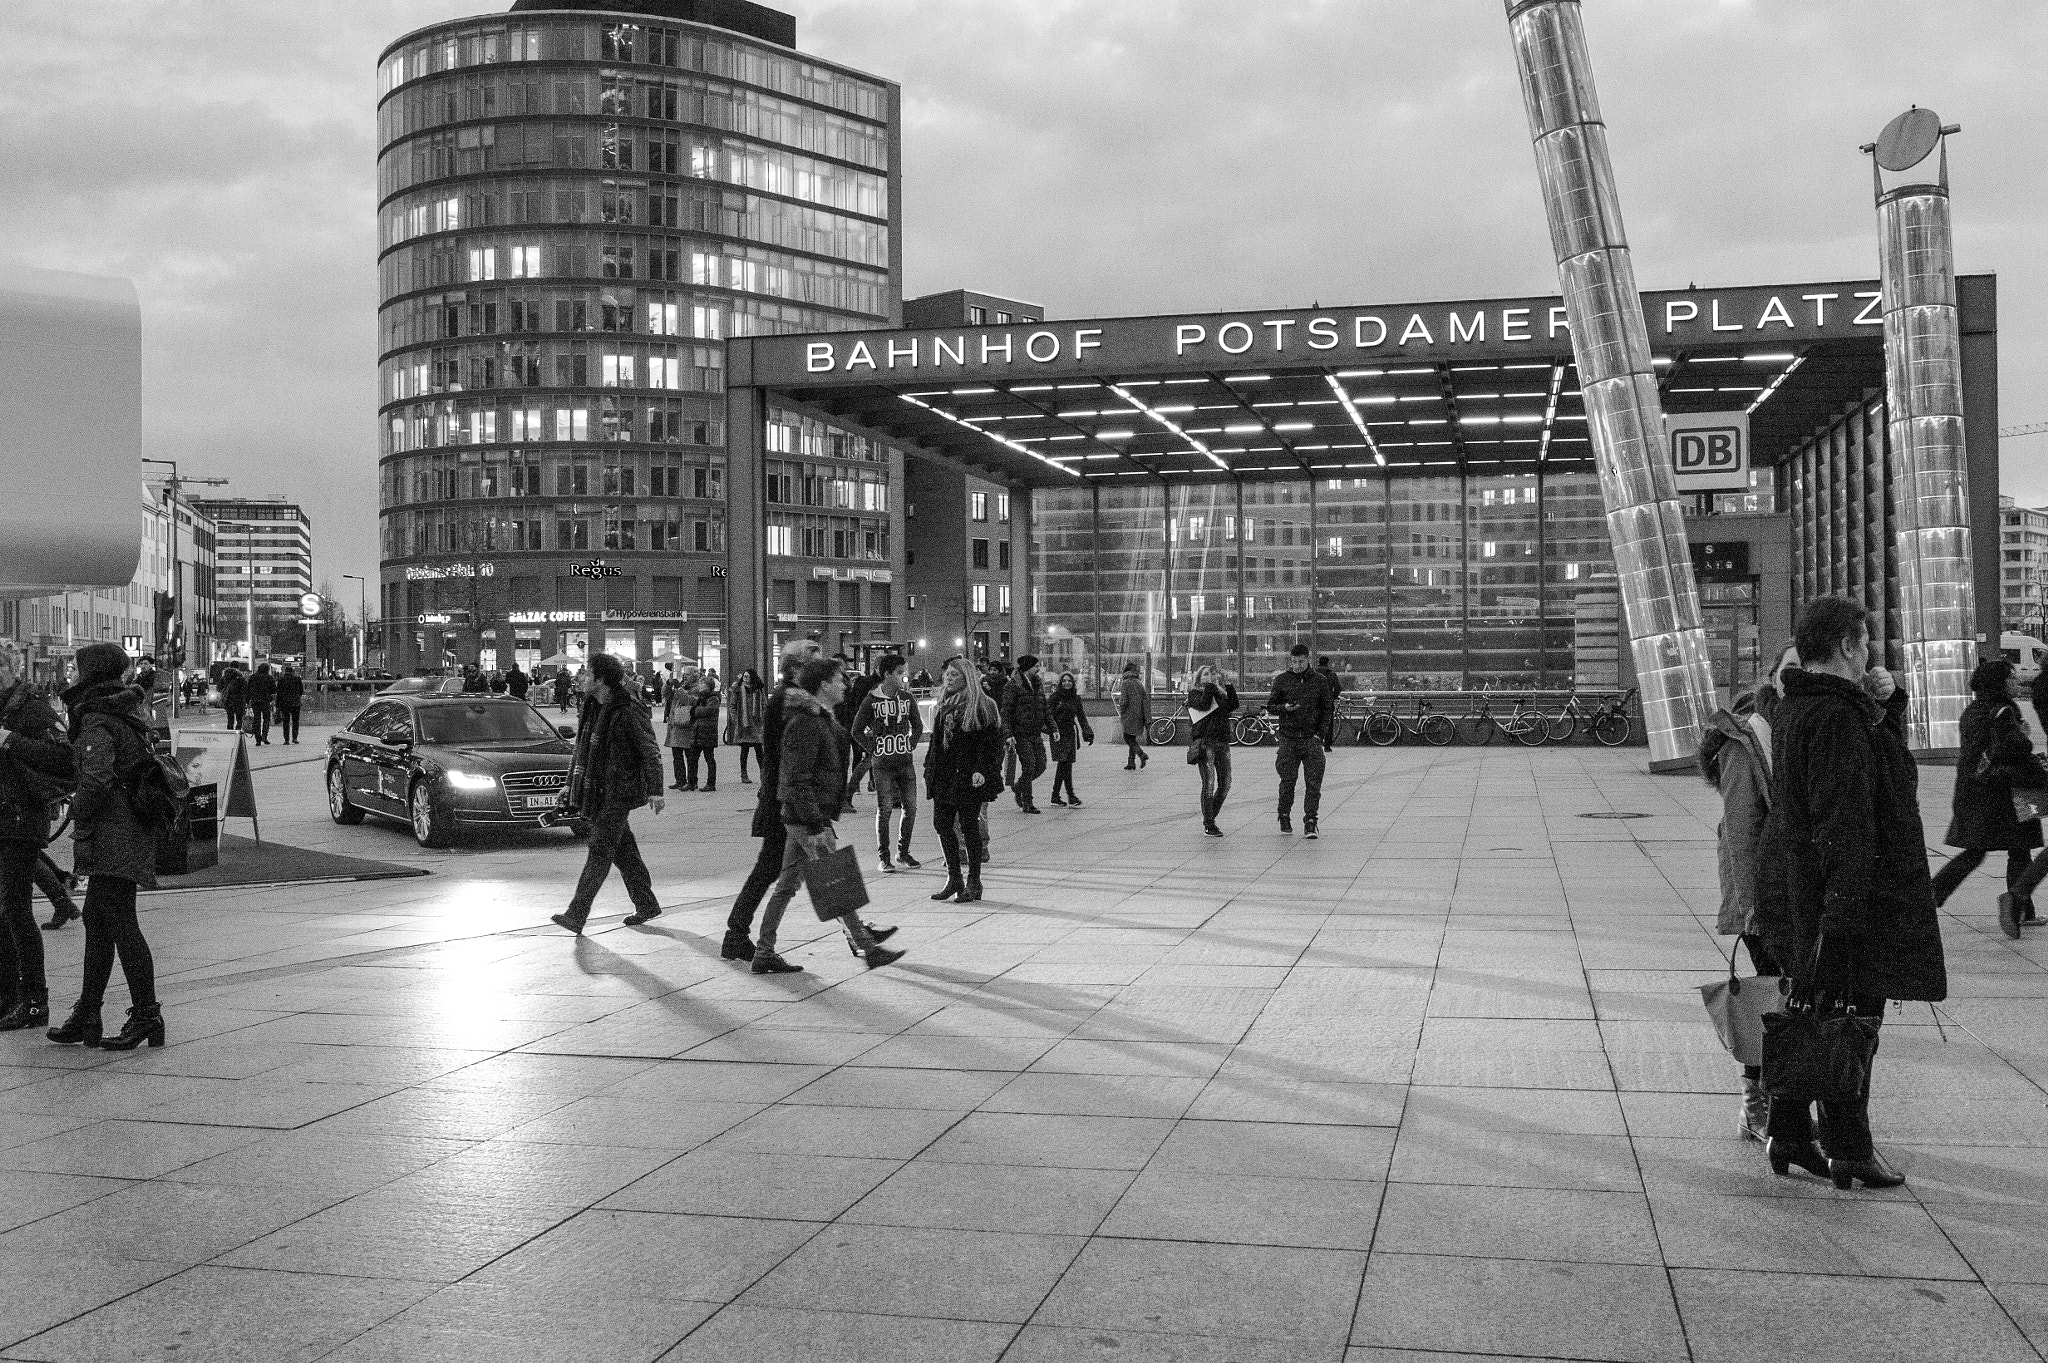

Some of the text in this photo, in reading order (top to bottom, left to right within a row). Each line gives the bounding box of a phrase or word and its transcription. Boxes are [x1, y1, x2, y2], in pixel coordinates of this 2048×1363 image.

[806, 292, 1884, 373] BAHNHOF POTSDAMER PLATZ
[1680, 434, 1732, 467] DB
[570, 562, 623, 579] Regus
[301, 594, 320, 615] S
[508, 610, 586, 623] BALZAC COFFEE
[616, 609, 683, 620] HypoVereinsbank
[125, 637, 137, 651] U
[871, 700, 896, 718] YOU
